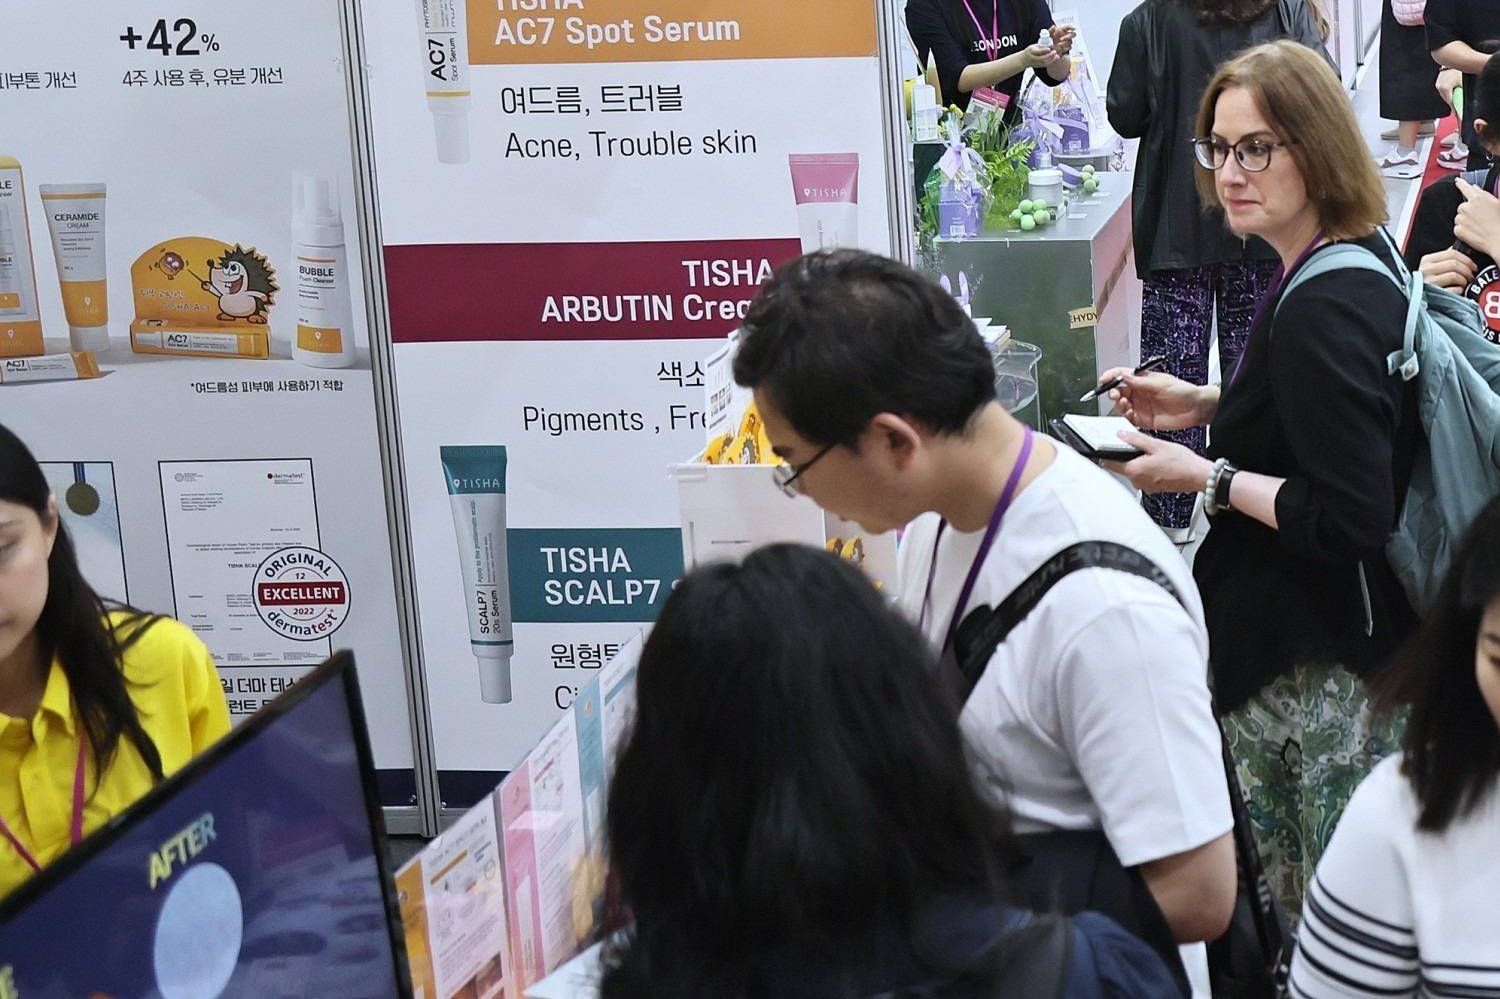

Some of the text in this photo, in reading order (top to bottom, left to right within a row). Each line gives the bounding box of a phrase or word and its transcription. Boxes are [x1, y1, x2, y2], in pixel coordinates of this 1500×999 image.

[495, 15, 741, 49] AC7 Spot Serum
[428, 38, 447, 81] AC7
[44, 71, 77, 90] 개선
[122, 67, 283, 88] 4주 사용 후, 유분 개선
[501, 83, 684, 118] 여드름, 트러블
[505, 129, 757, 160] Acne, Trouble skin
[54, 212, 100, 222] CERAMIDE
[299, 265, 334, 277] BUBBLE
[682, 259, 774, 288] TISHA
[541, 294, 673, 323] ARBUTIN
[278, 380, 320, 392] 사용하기
[323, 379, 344, 392] 적합
[523, 405, 644, 437] Pigments
[463, 478, 500, 489] TISHA
[264, 553, 332, 579] ORIGINAL
[540, 547, 632, 573] TISHA
[263, 586, 340, 601] EXCELLENT
[491, 590, 499, 616] Serum
[545, 579, 661, 606] SCALP7
[268, 610, 337, 637] dermatest
[293, 607, 314, 615] 2022
[477, 590, 489, 634] SCALP7
[237, 678, 267, 694] 더마
[148, 812, 217, 889] AFTER
